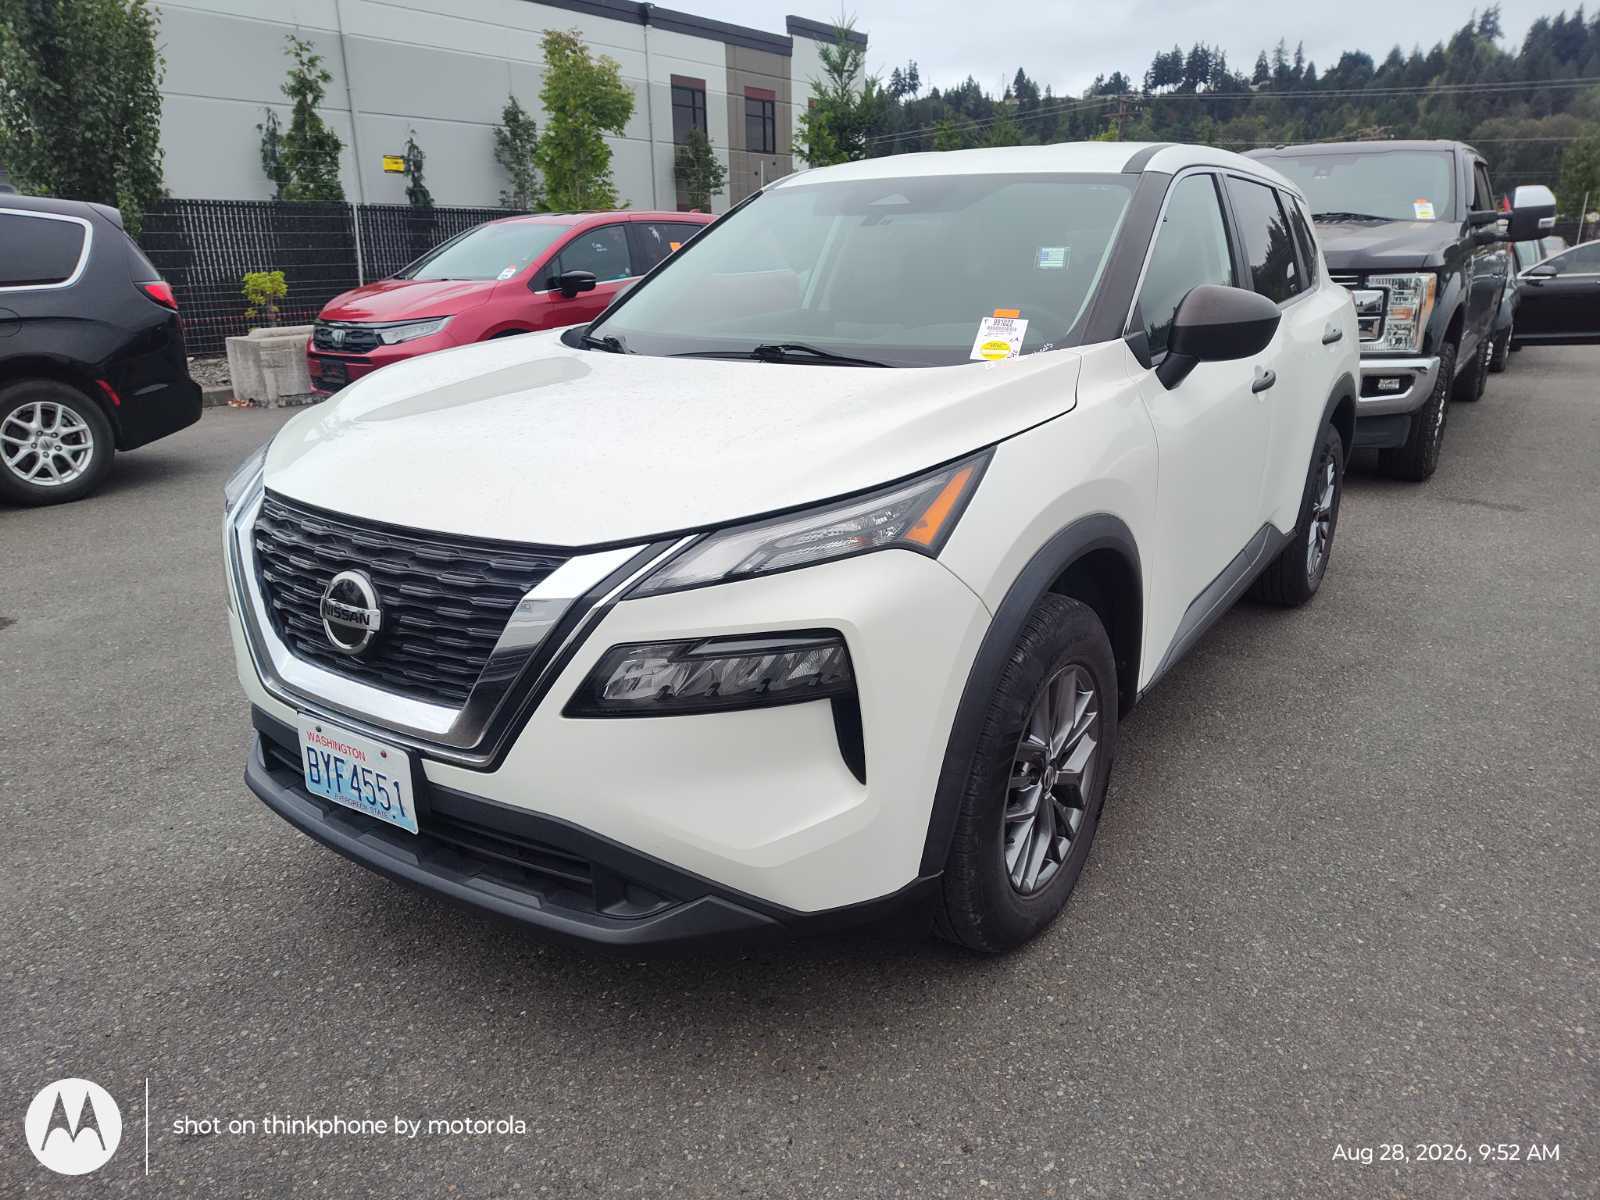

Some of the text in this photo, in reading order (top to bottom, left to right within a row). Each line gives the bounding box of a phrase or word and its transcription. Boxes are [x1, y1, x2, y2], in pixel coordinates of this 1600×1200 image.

[322, 600, 370, 626] NISSAN
[307, 731, 367, 762] WASHINGTON
[306, 745, 405, 818] BYF4551
